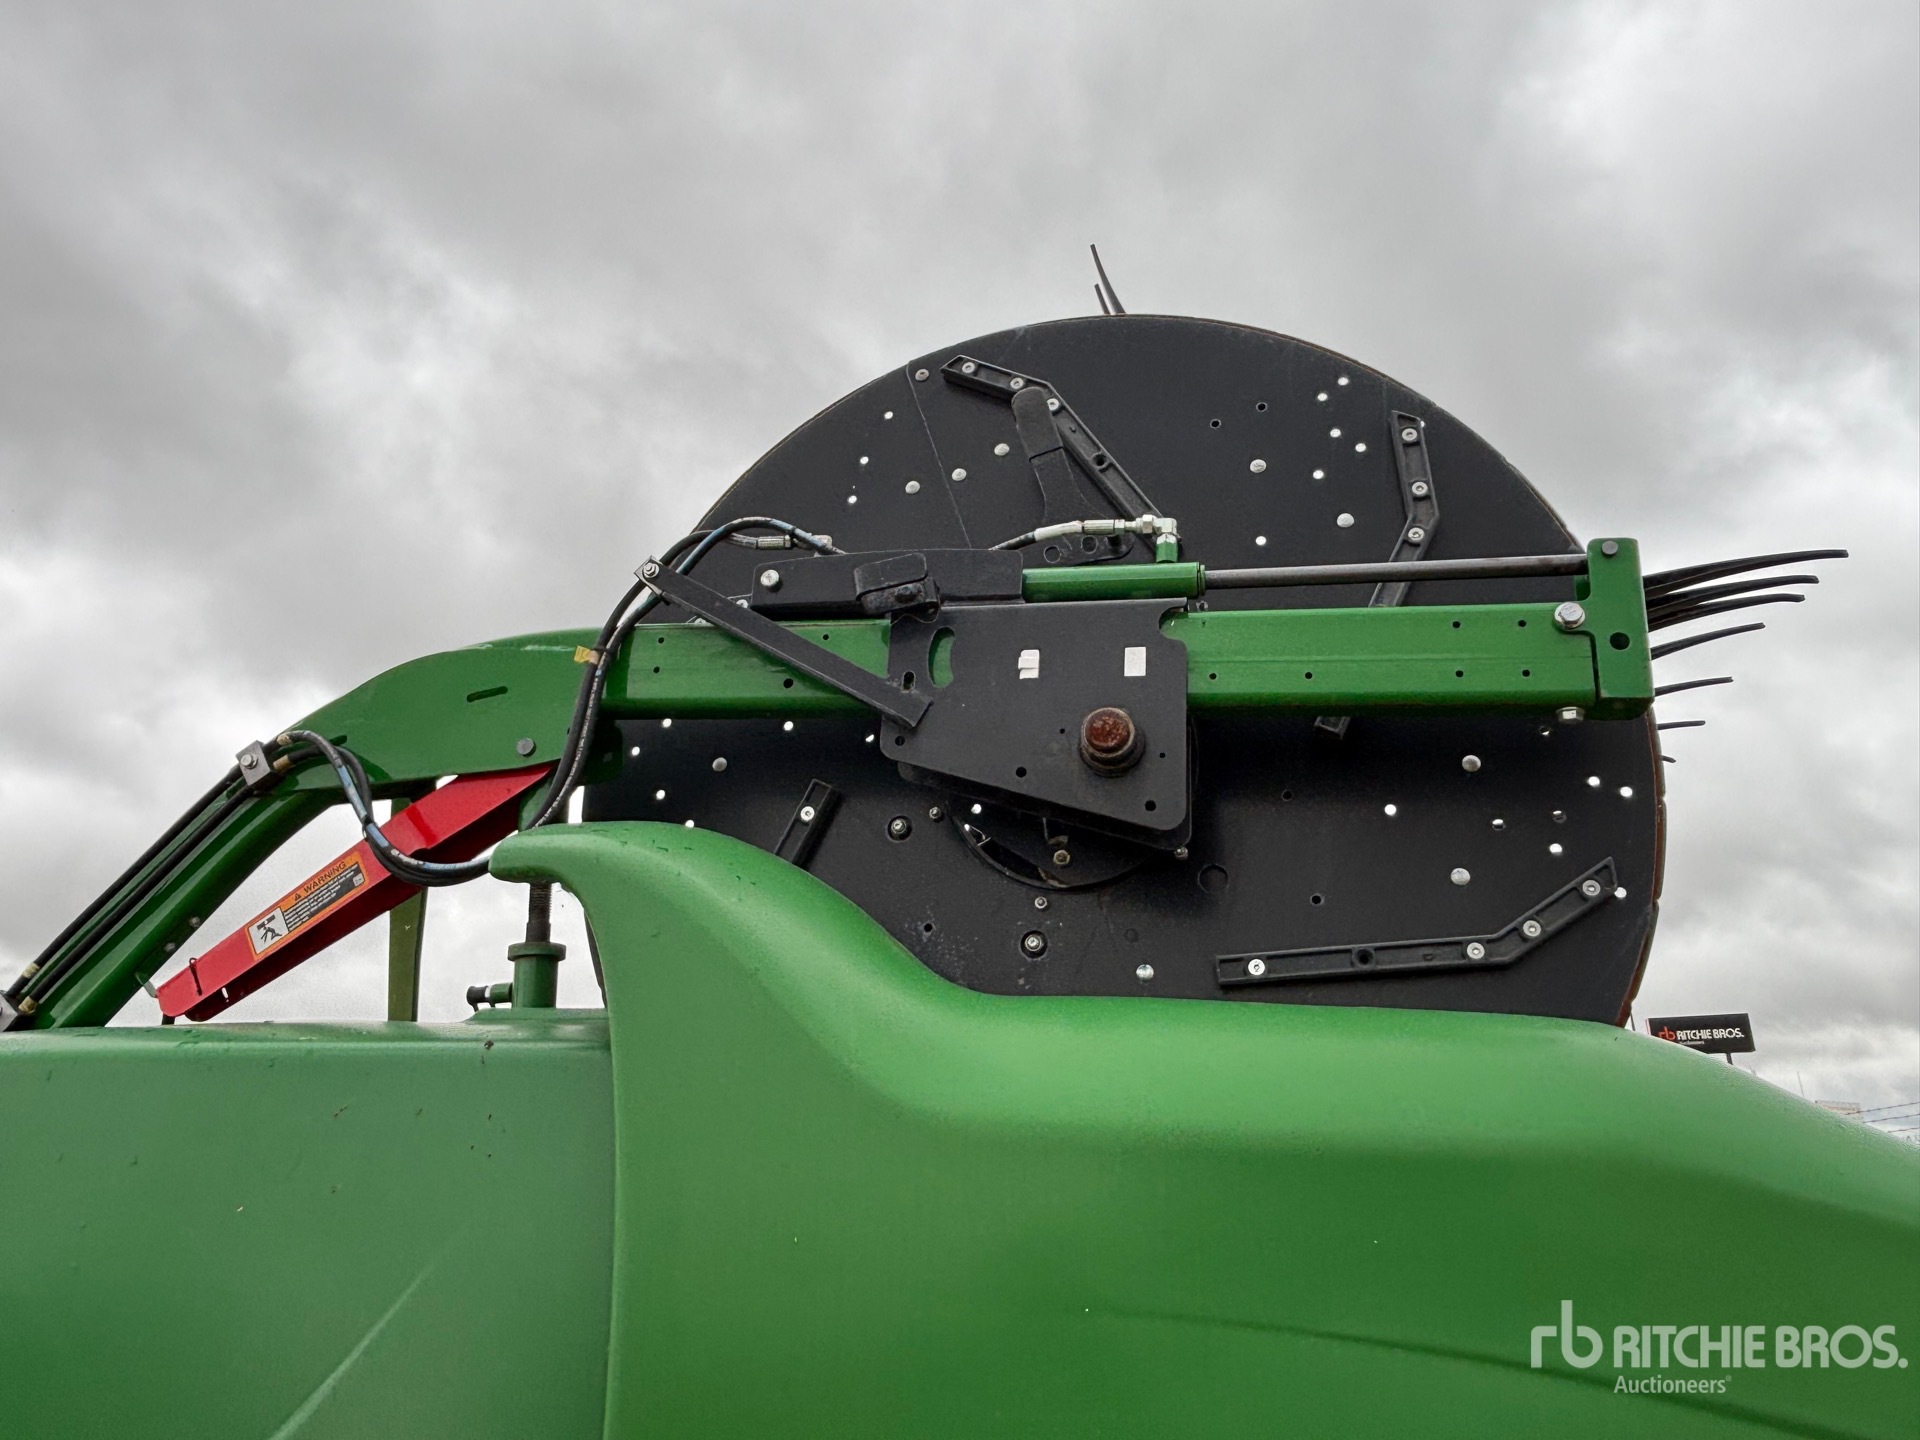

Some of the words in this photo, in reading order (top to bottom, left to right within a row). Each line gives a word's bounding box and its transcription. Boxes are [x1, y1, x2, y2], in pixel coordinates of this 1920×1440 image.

[303, 861, 347, 893] WARNING
[1676, 1029, 1712, 1040] RITCHIE
[1713, 1028, 1745, 1038] BROS.
